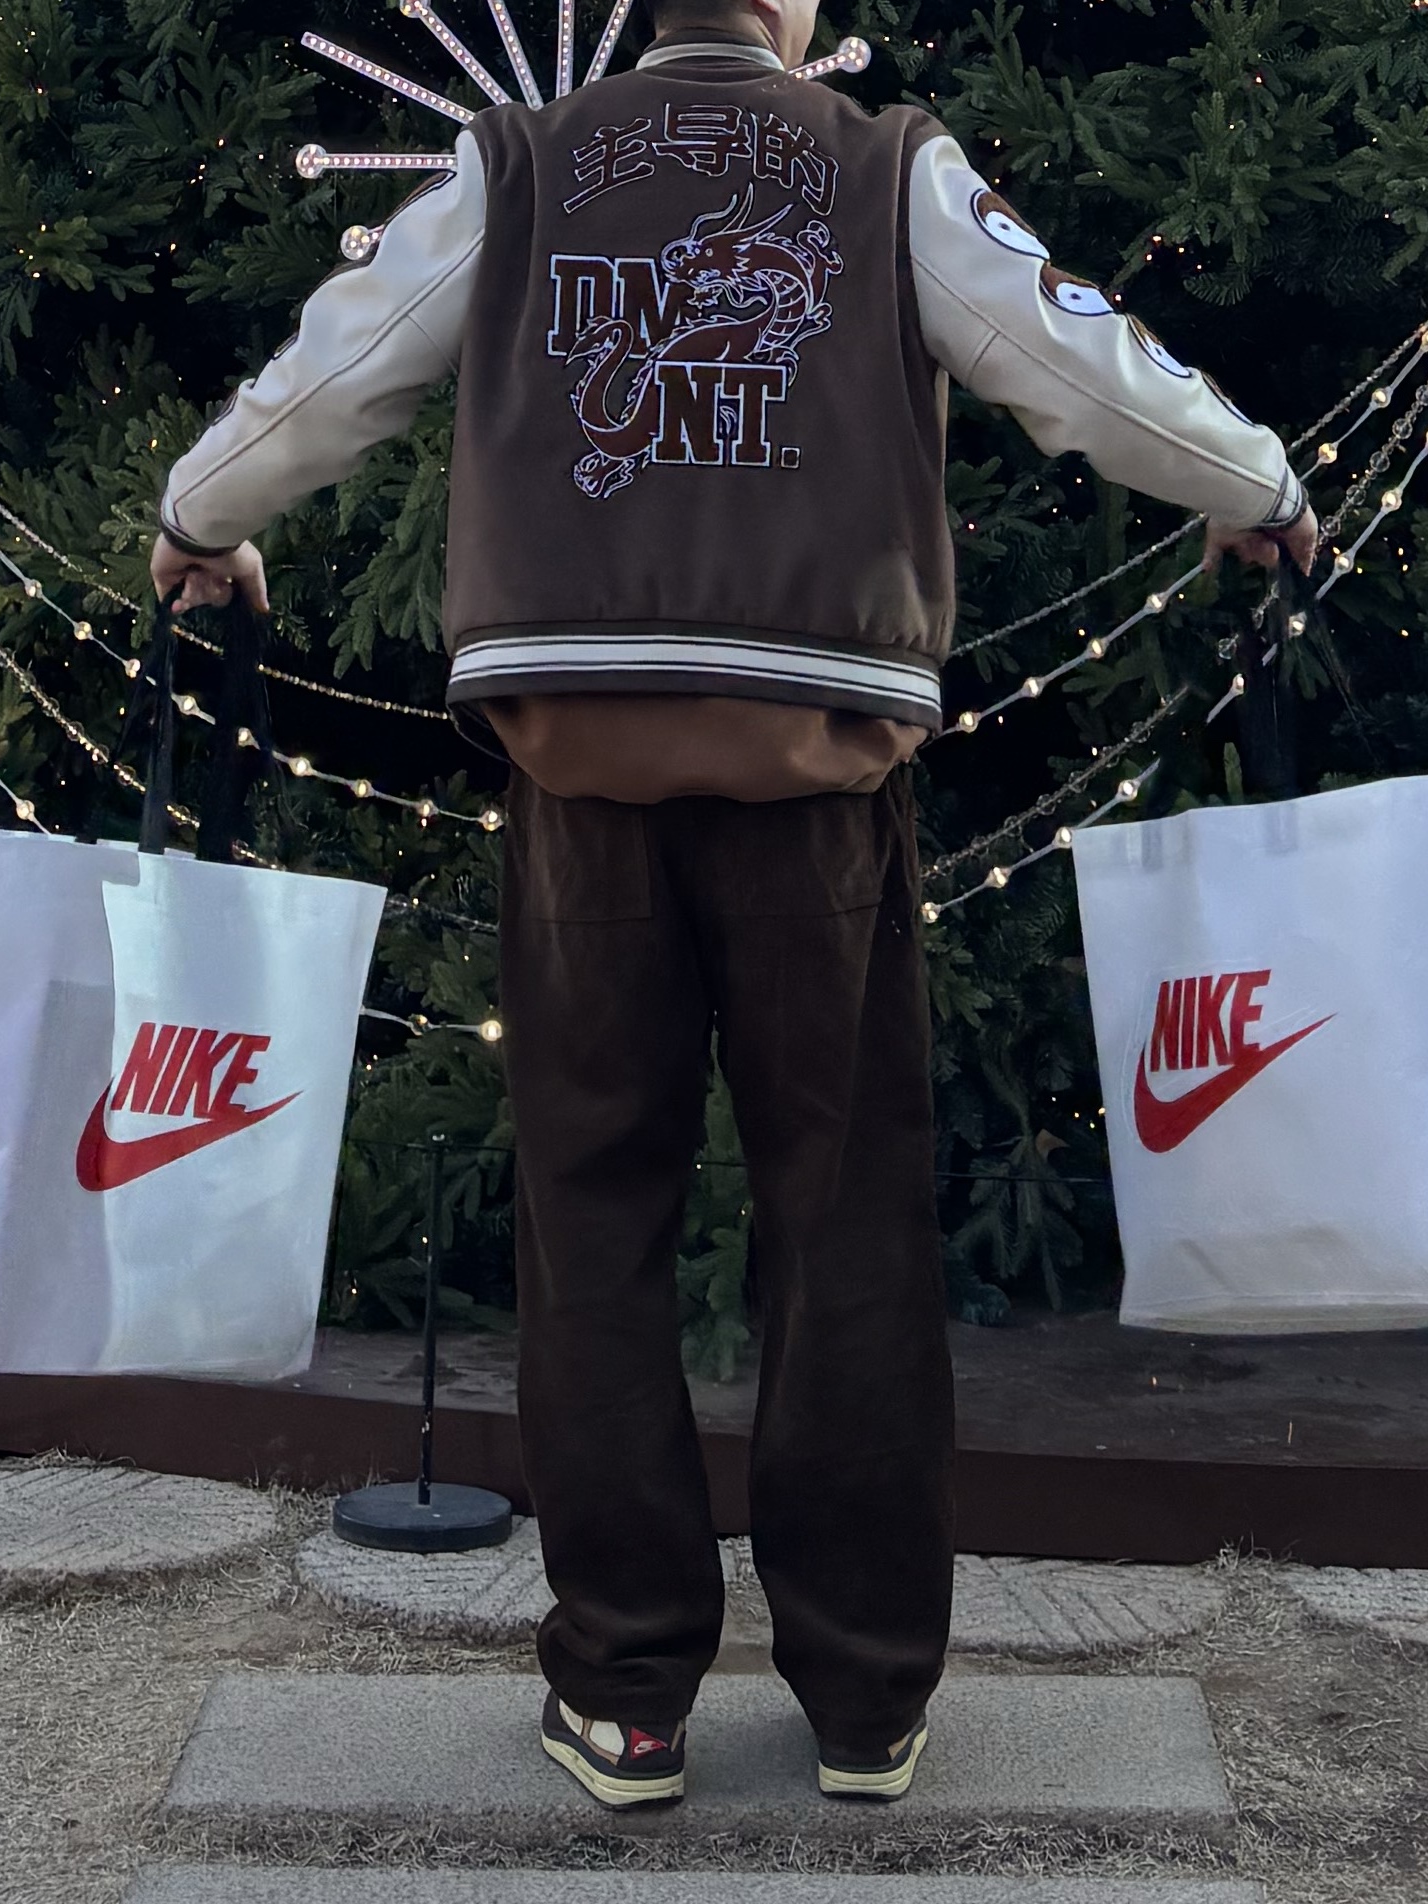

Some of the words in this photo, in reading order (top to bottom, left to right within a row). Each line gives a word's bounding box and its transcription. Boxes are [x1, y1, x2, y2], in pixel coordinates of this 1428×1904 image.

[563, 103, 839, 216] 主导的
[111, 1022, 271, 1118] NIKE
[1150, 969, 1271, 1072] NIKE
